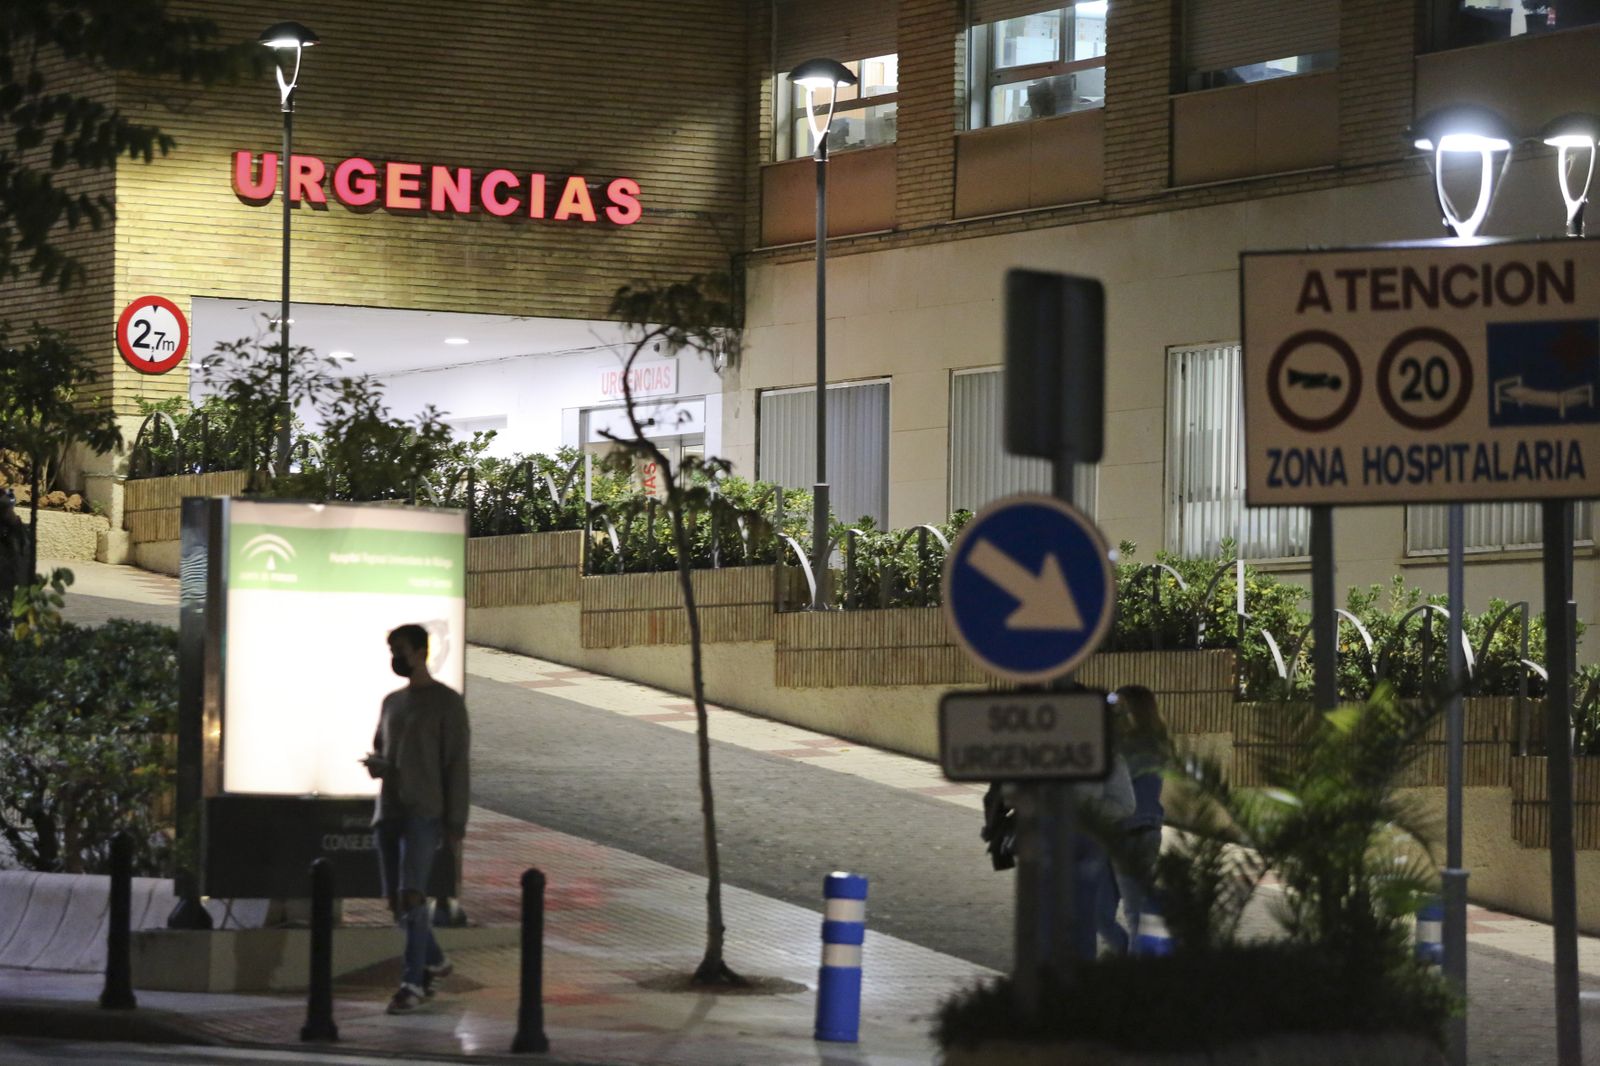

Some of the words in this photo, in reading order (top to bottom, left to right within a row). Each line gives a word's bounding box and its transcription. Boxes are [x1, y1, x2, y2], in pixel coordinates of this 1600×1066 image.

[232, 149, 643, 226] URGENCIAS
[1295, 259, 1575, 315] ATENCION
[1399, 356, 1449, 402] 20
[1266, 447, 1348, 488] ZONA
[1363, 439, 1586, 485] HOSPITALARIA
[988, 704, 1056, 733] SOLO
[322, 833, 376, 851] CONSEJE
